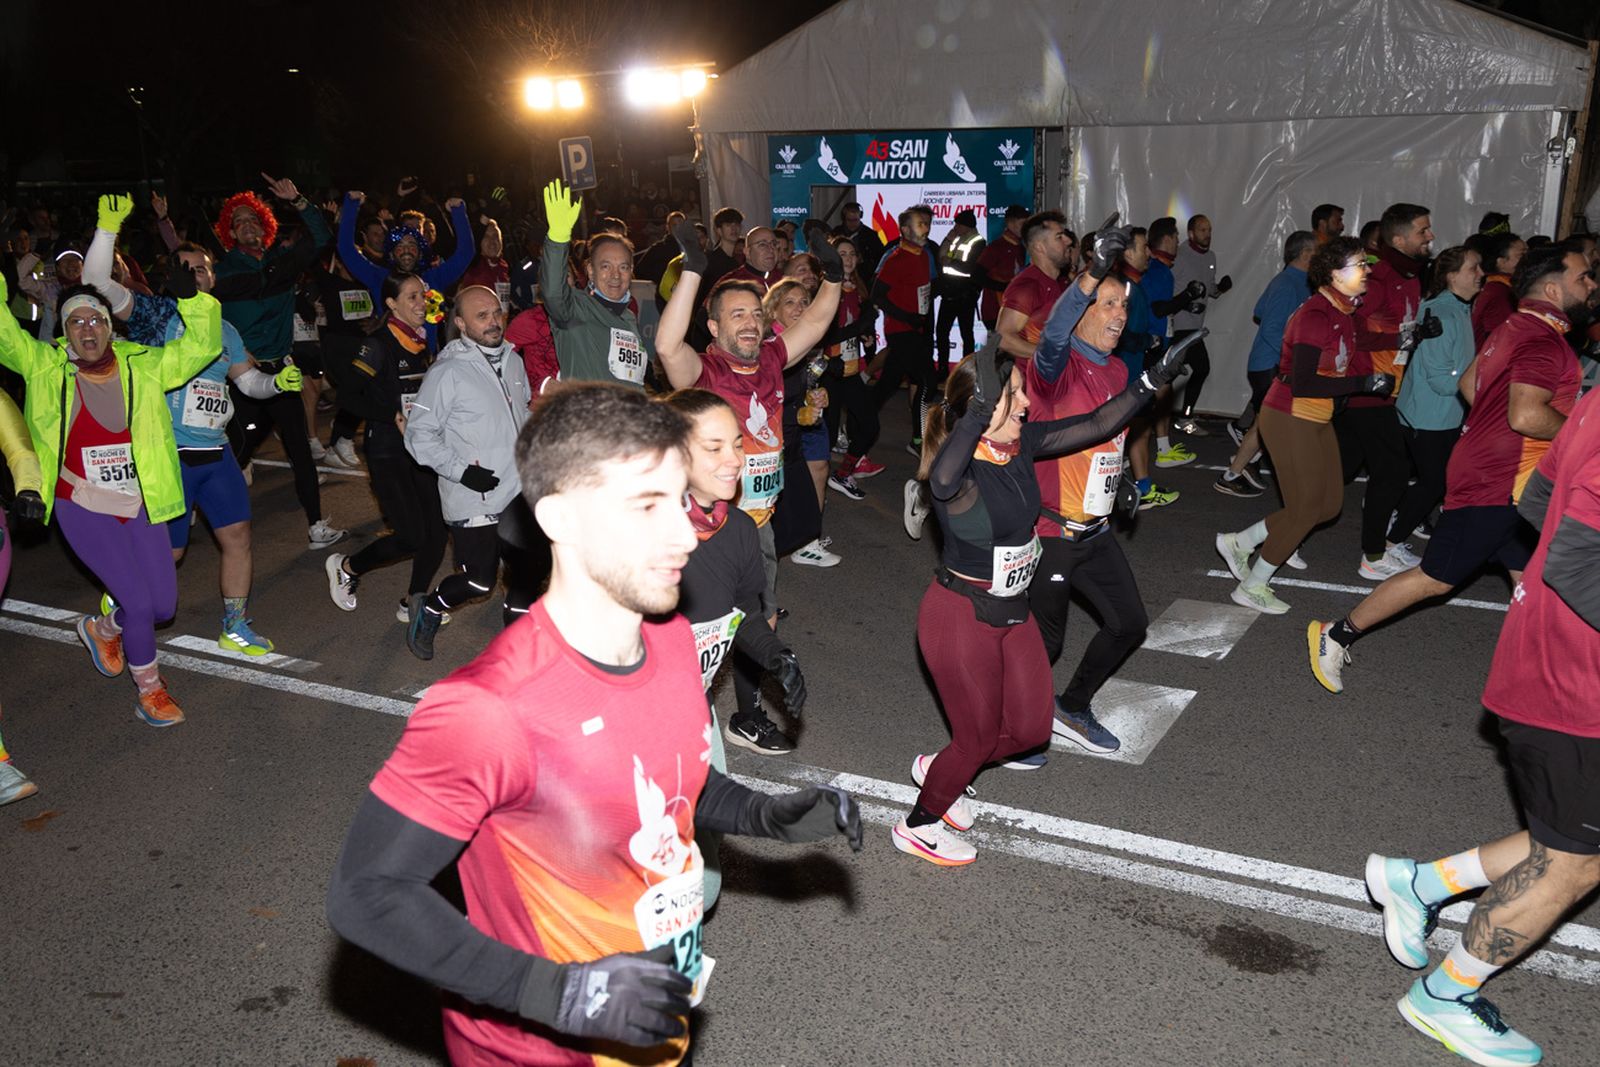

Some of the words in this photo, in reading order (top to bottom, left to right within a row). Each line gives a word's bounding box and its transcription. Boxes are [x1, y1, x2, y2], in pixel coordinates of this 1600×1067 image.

[866, 140, 889, 161] 43
[889, 139, 929, 159] SAN
[568, 144, 587, 185] P
[827, 163, 839, 176] 43
[861, 155, 926, 179] ANTÓN
[953, 160, 965, 175] 43
[619, 348, 642, 367] 5951
[196, 396, 229, 415] 2020
[99, 450, 118, 458] NOCHE
[99, 462, 137, 482] 5513
[749, 468, 761, 476] SAN
[656, 917, 682, 938] SAN
